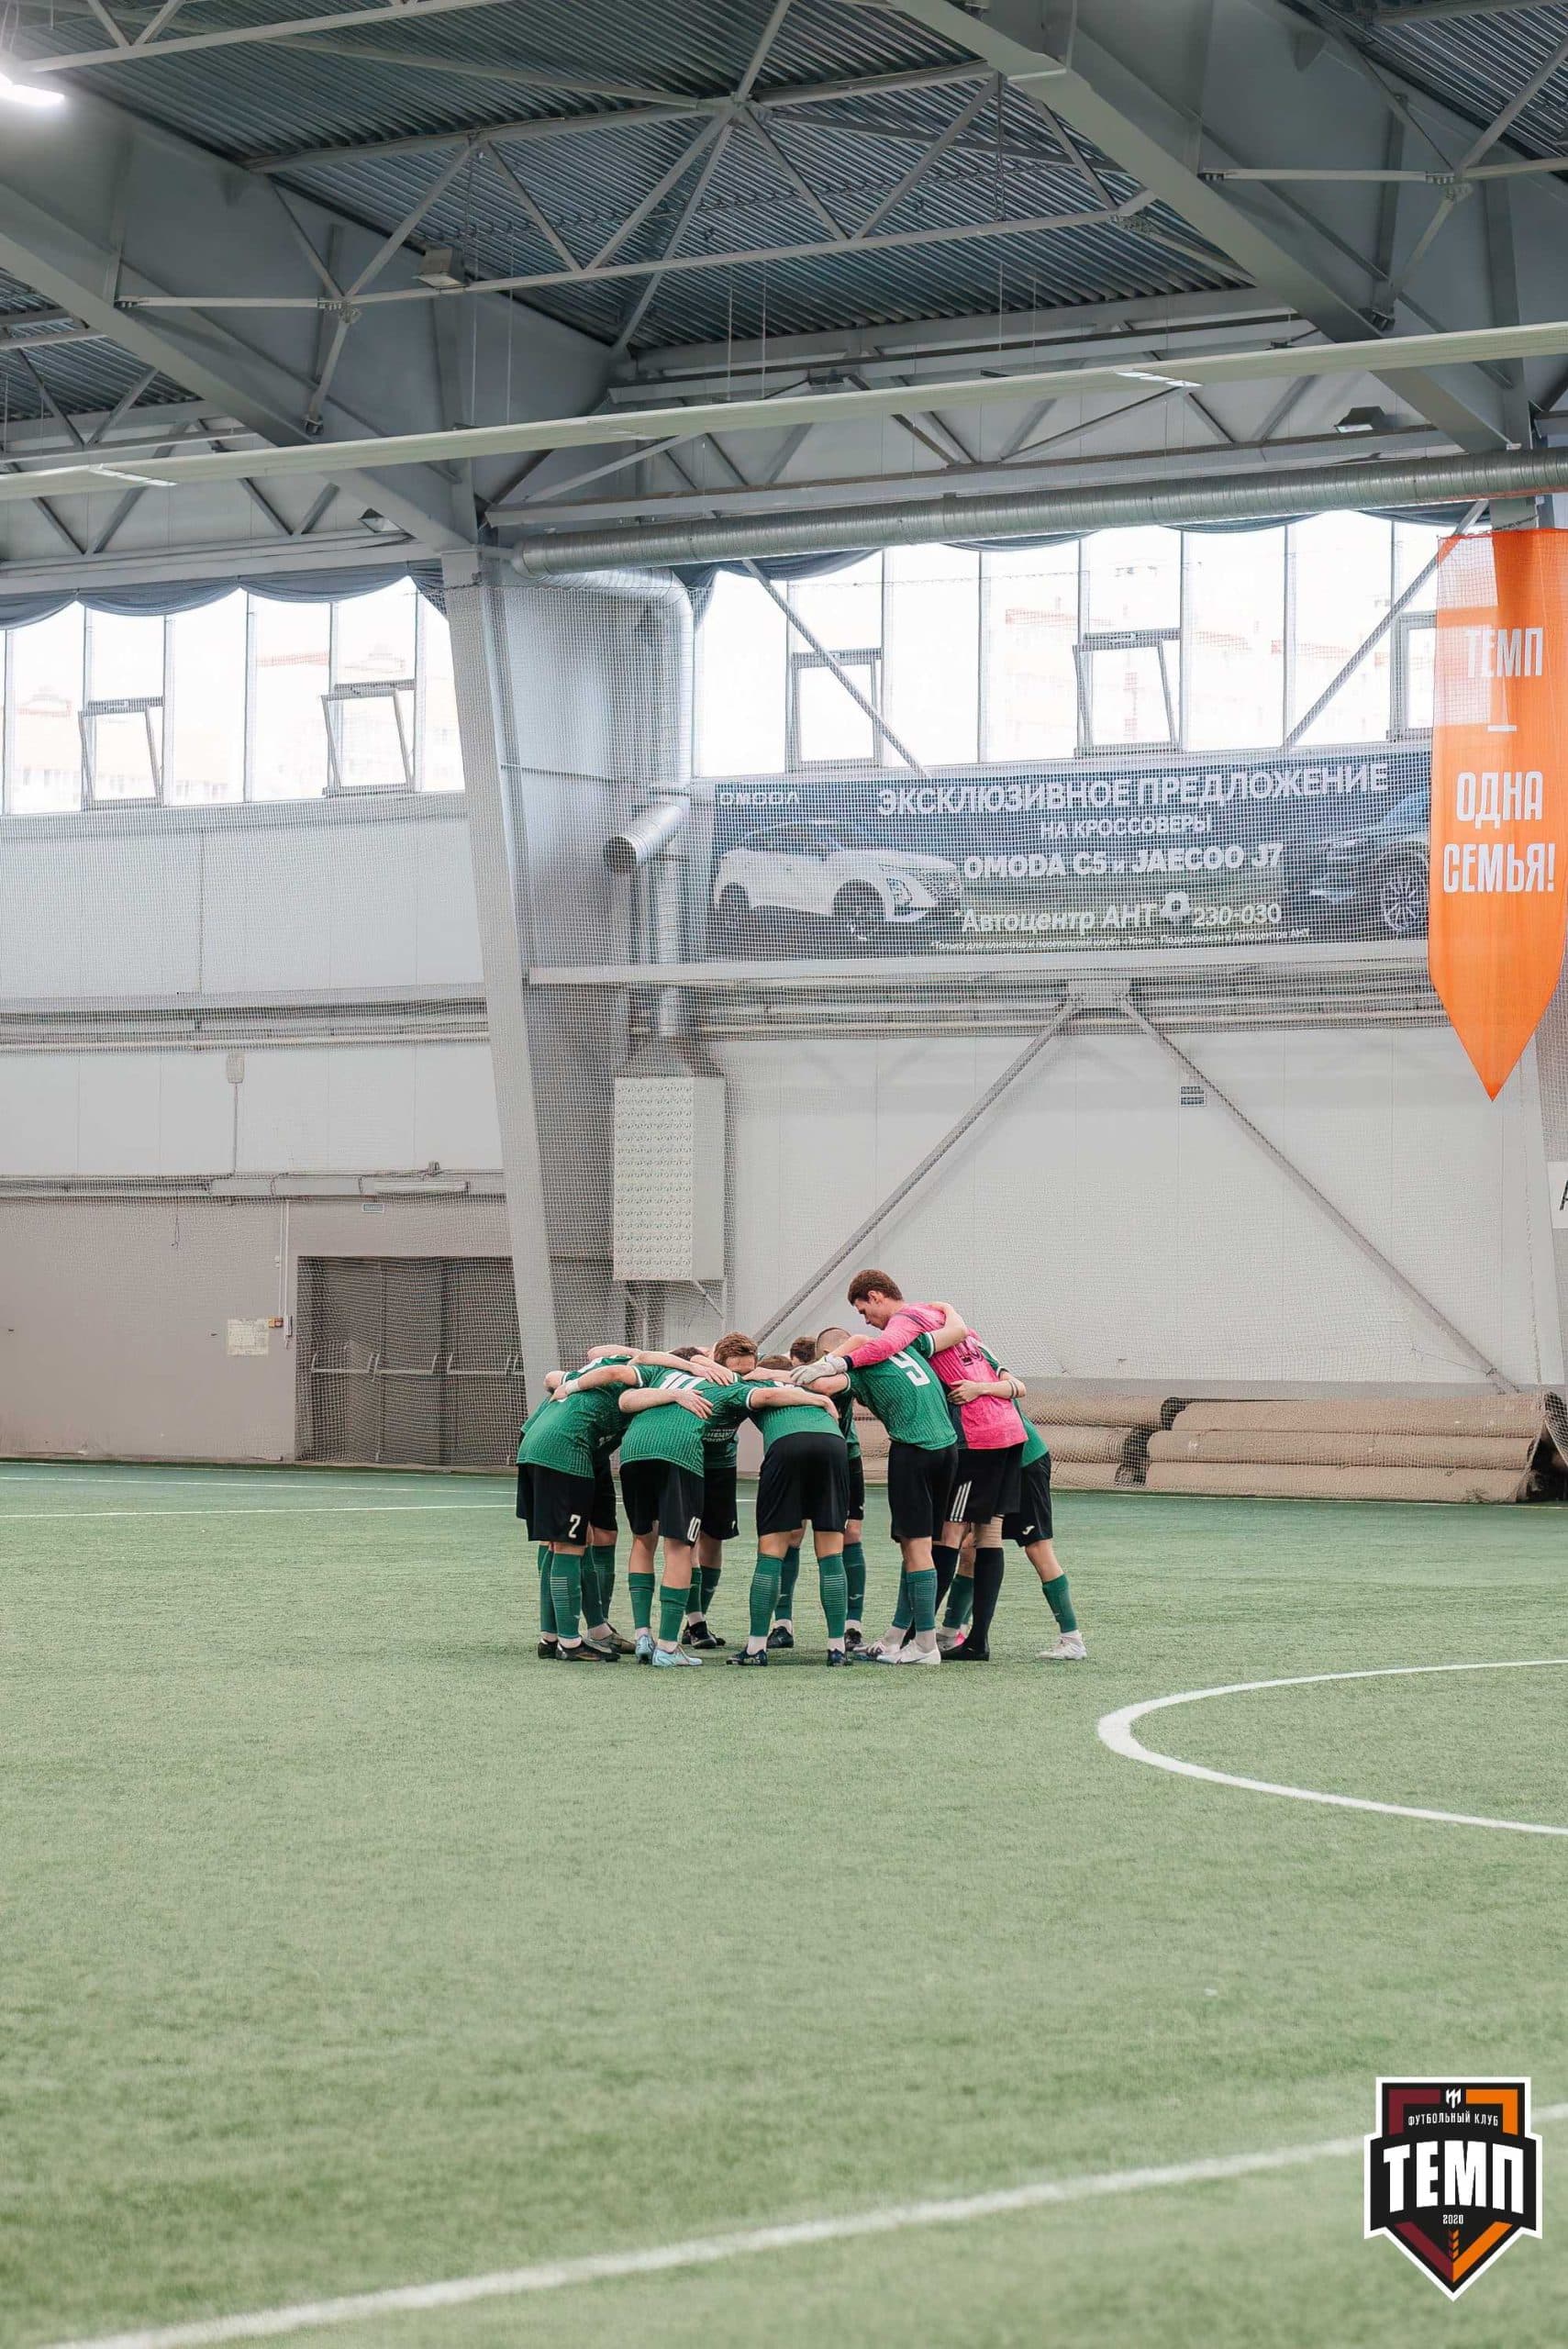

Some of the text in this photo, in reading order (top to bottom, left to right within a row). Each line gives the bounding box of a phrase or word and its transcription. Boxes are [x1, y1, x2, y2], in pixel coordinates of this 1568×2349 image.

[1465, 628, 1543, 677] ТЕМП
[878, 763, 1388, 815] ЭКСКЛЮЗИВНОЕ ПРЕДЛОЖЕНИЕ
[1457, 771, 1542, 829] ОДНА
[1040, 812, 1211, 839] НА КРОССОВЕРЫ
[964, 843, 1284, 879] OMODA C5 и JAECOO J7
[1443, 843, 1555, 893] СЕМЬЯ!
[1101, 903, 1158, 928] АНТ
[1193, 903, 1282, 926] 230-030
[568, 1514, 582, 1539] 2
[687, 1516, 702, 1542] 10
